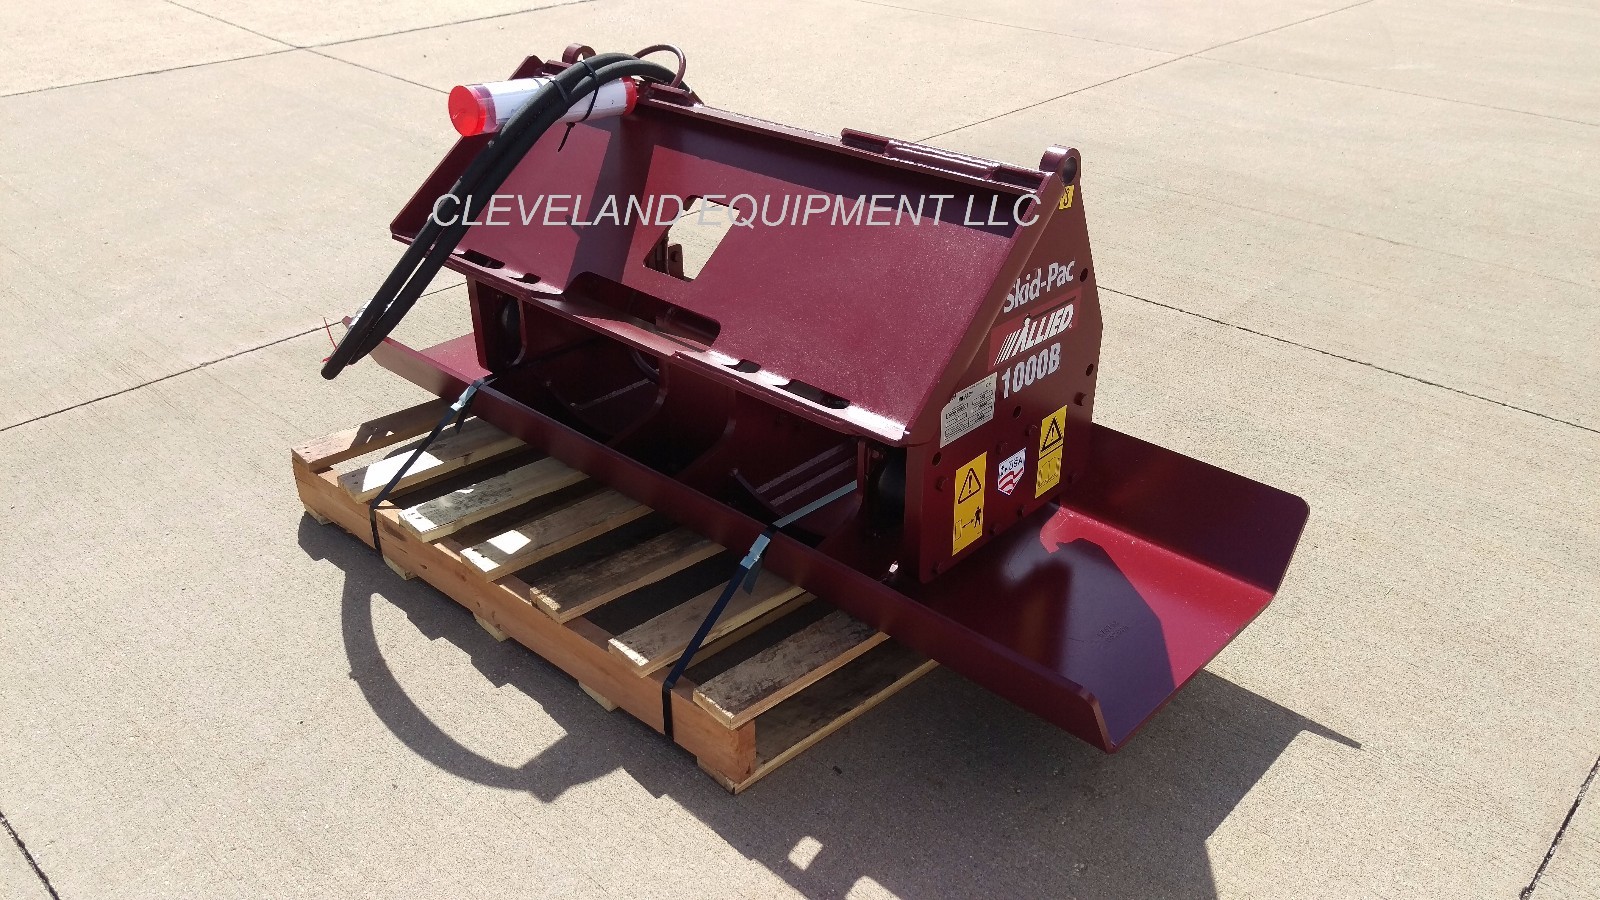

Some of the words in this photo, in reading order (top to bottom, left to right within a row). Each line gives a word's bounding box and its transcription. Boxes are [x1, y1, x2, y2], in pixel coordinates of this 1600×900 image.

[1004, 303, 1074, 359] ALLIED
[1002, 342, 1062, 399] 1000B
[1008, 456, 1023, 471] USA
